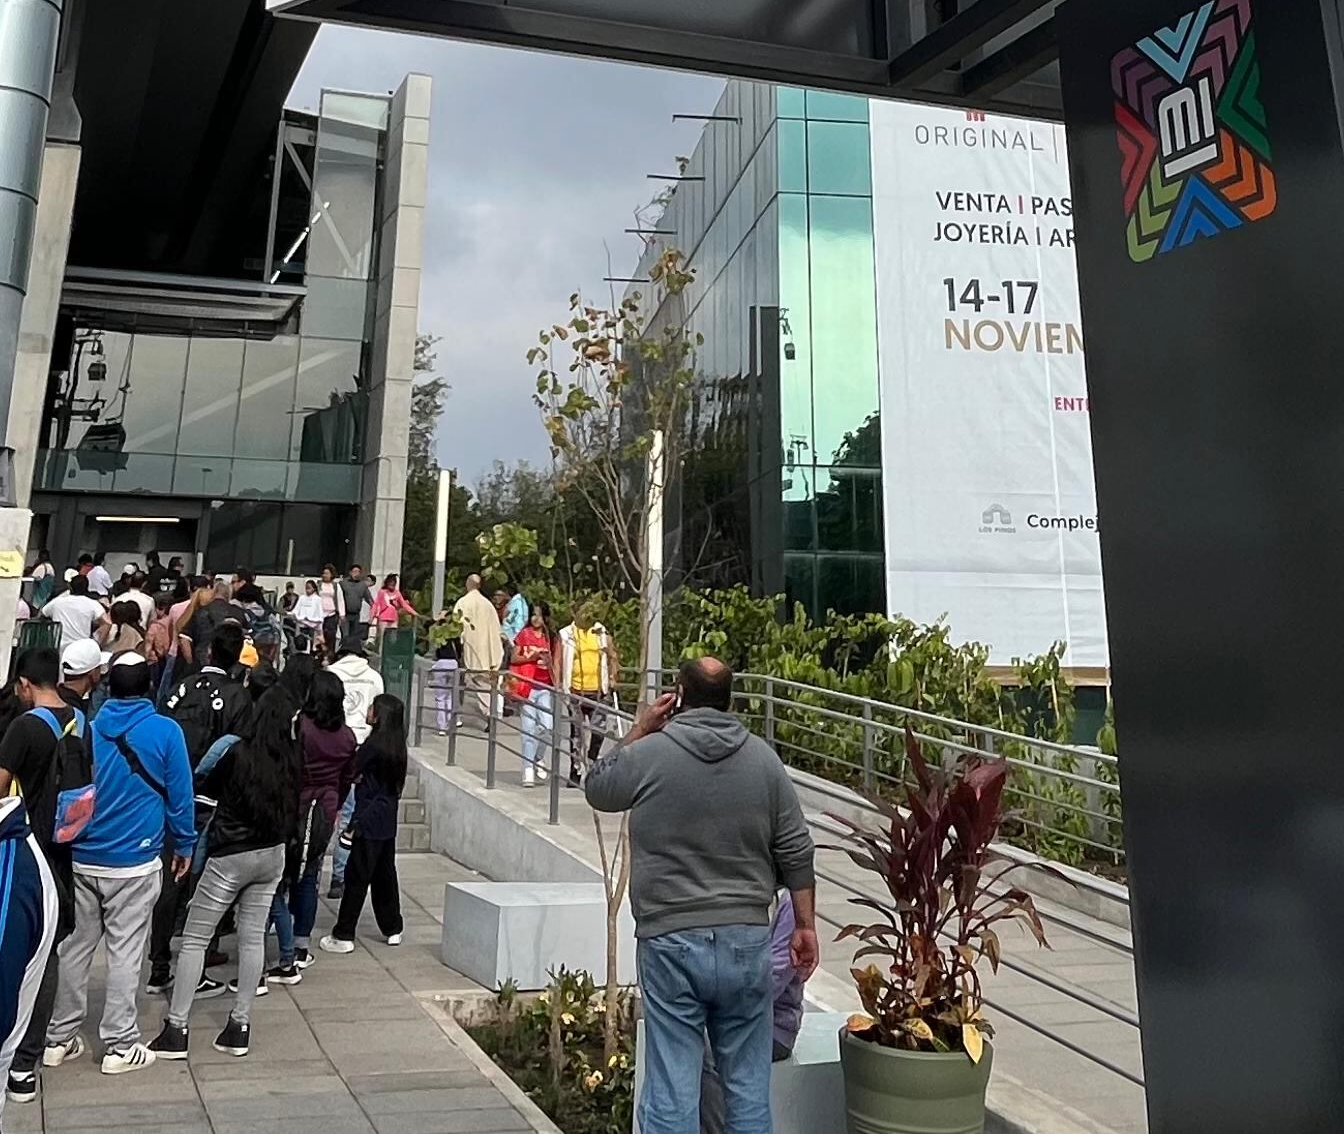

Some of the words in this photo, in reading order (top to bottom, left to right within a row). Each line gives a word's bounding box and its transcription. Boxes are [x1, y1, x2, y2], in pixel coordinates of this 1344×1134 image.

[915, 125, 1044, 151] ORIGINAL
[936, 191, 1012, 214] VENTA
[1031, 196, 1073, 217] PAS
[934, 221, 1029, 246] JOYERÍA
[943, 277, 1039, 314] 14-17
